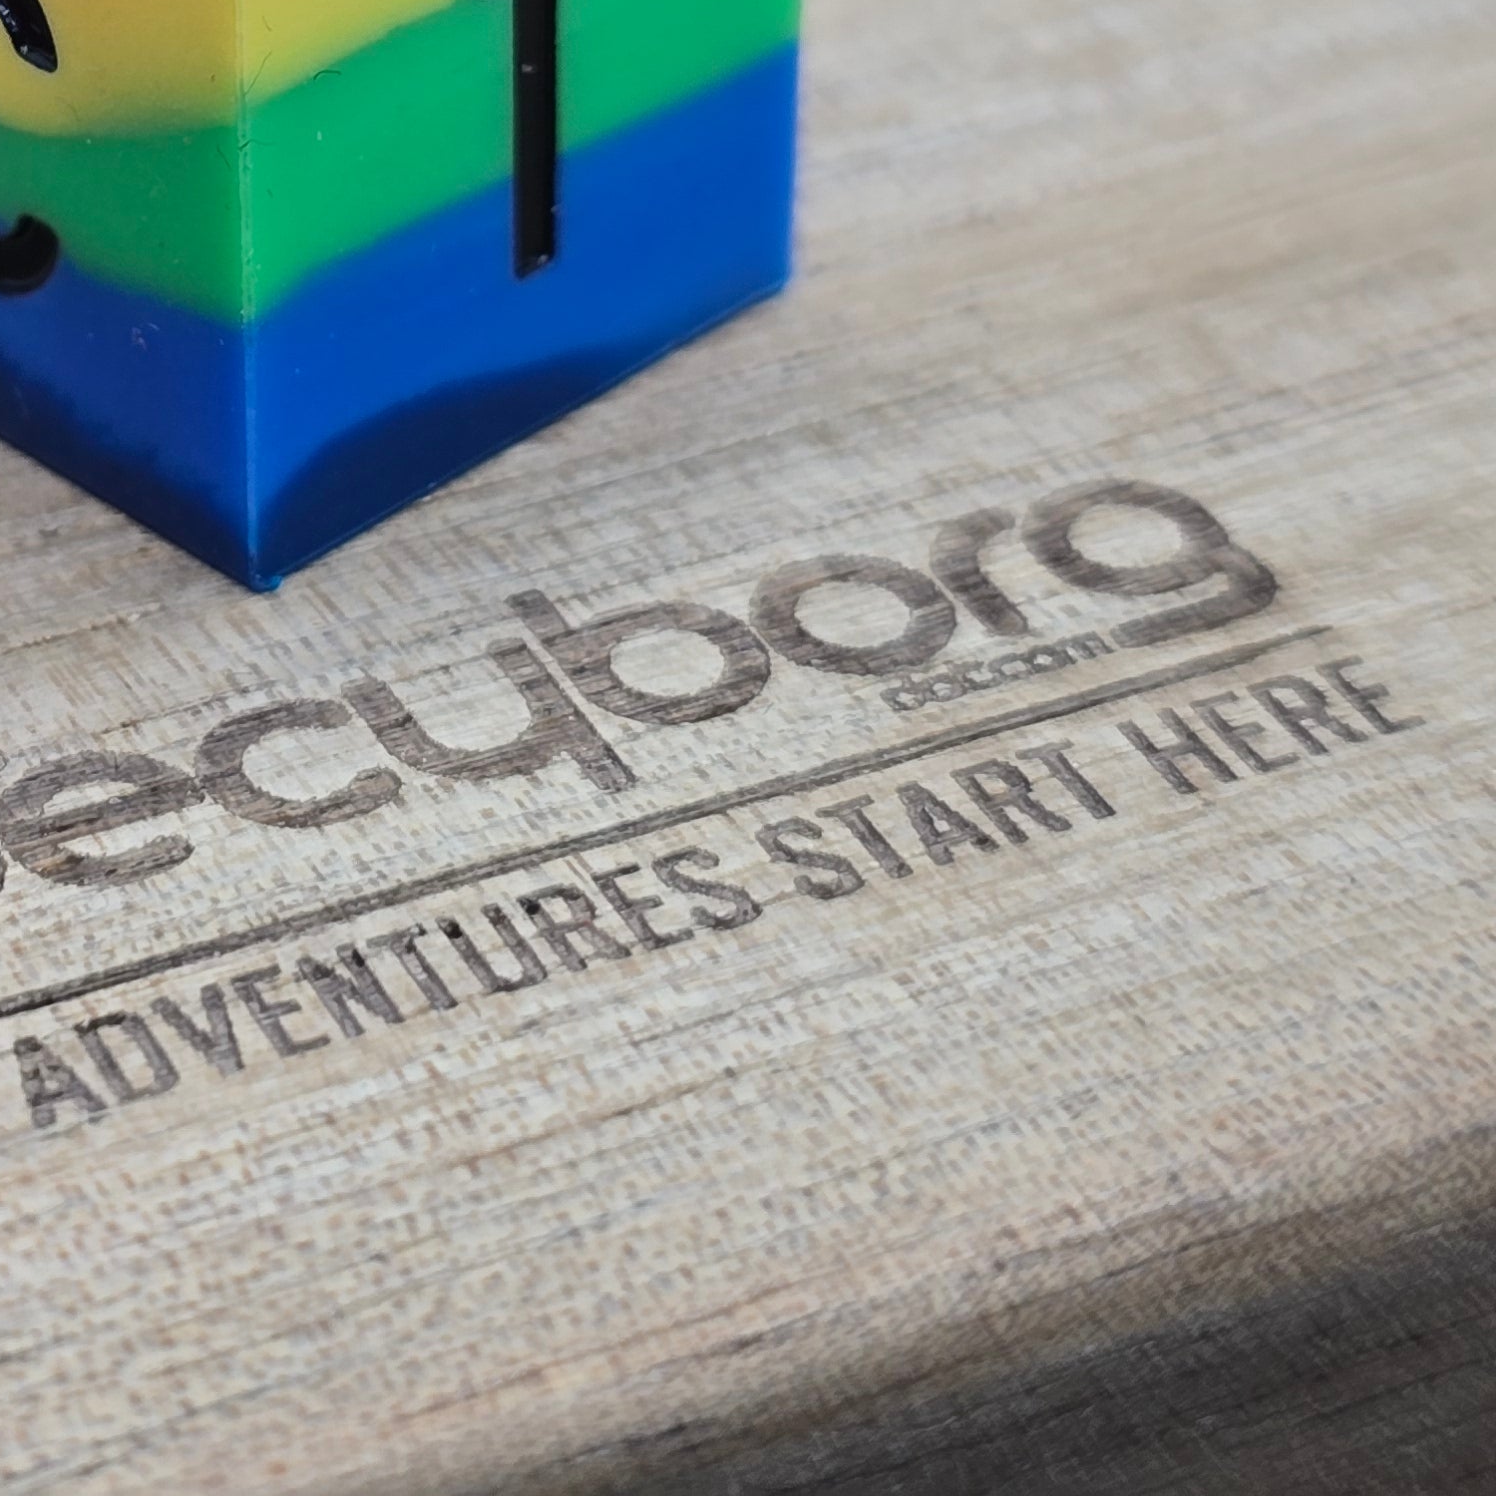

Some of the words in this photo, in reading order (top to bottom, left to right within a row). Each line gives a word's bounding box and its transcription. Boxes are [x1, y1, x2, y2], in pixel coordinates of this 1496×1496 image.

[12, 844, 765, 1129] ADVENTURES
[754, 737, 1117, 901] START
[1115, 654, 1427, 796] HERE
